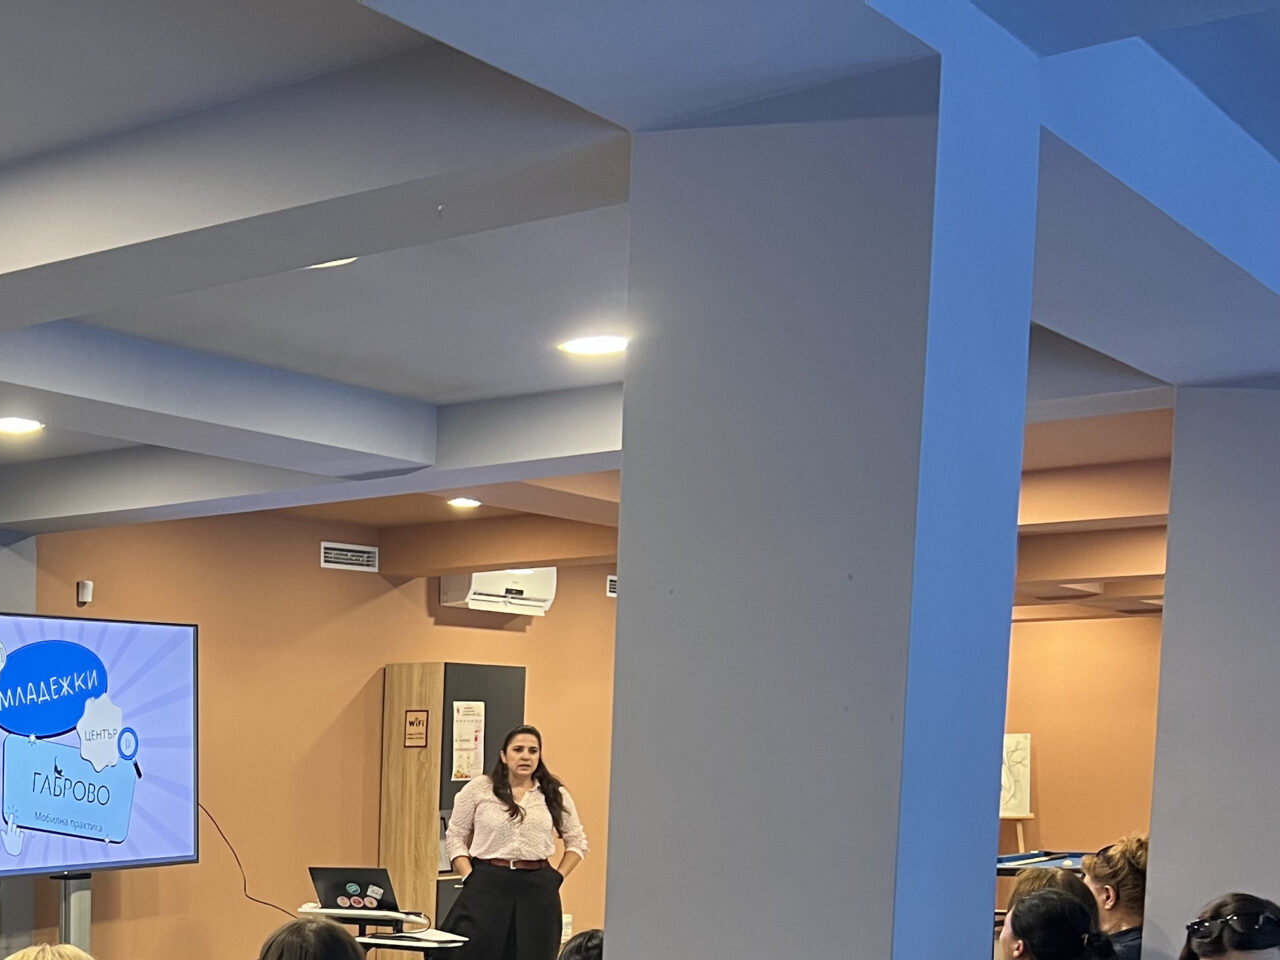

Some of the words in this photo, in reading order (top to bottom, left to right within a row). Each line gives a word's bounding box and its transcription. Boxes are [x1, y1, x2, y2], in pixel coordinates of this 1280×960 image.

[84, 728, 118, 742] ЦЕНТЪР
[32, 771, 111, 806] ГАБРОВО
[34, 811, 69, 827] Мобилна
[70, 819, 103, 833] практика
